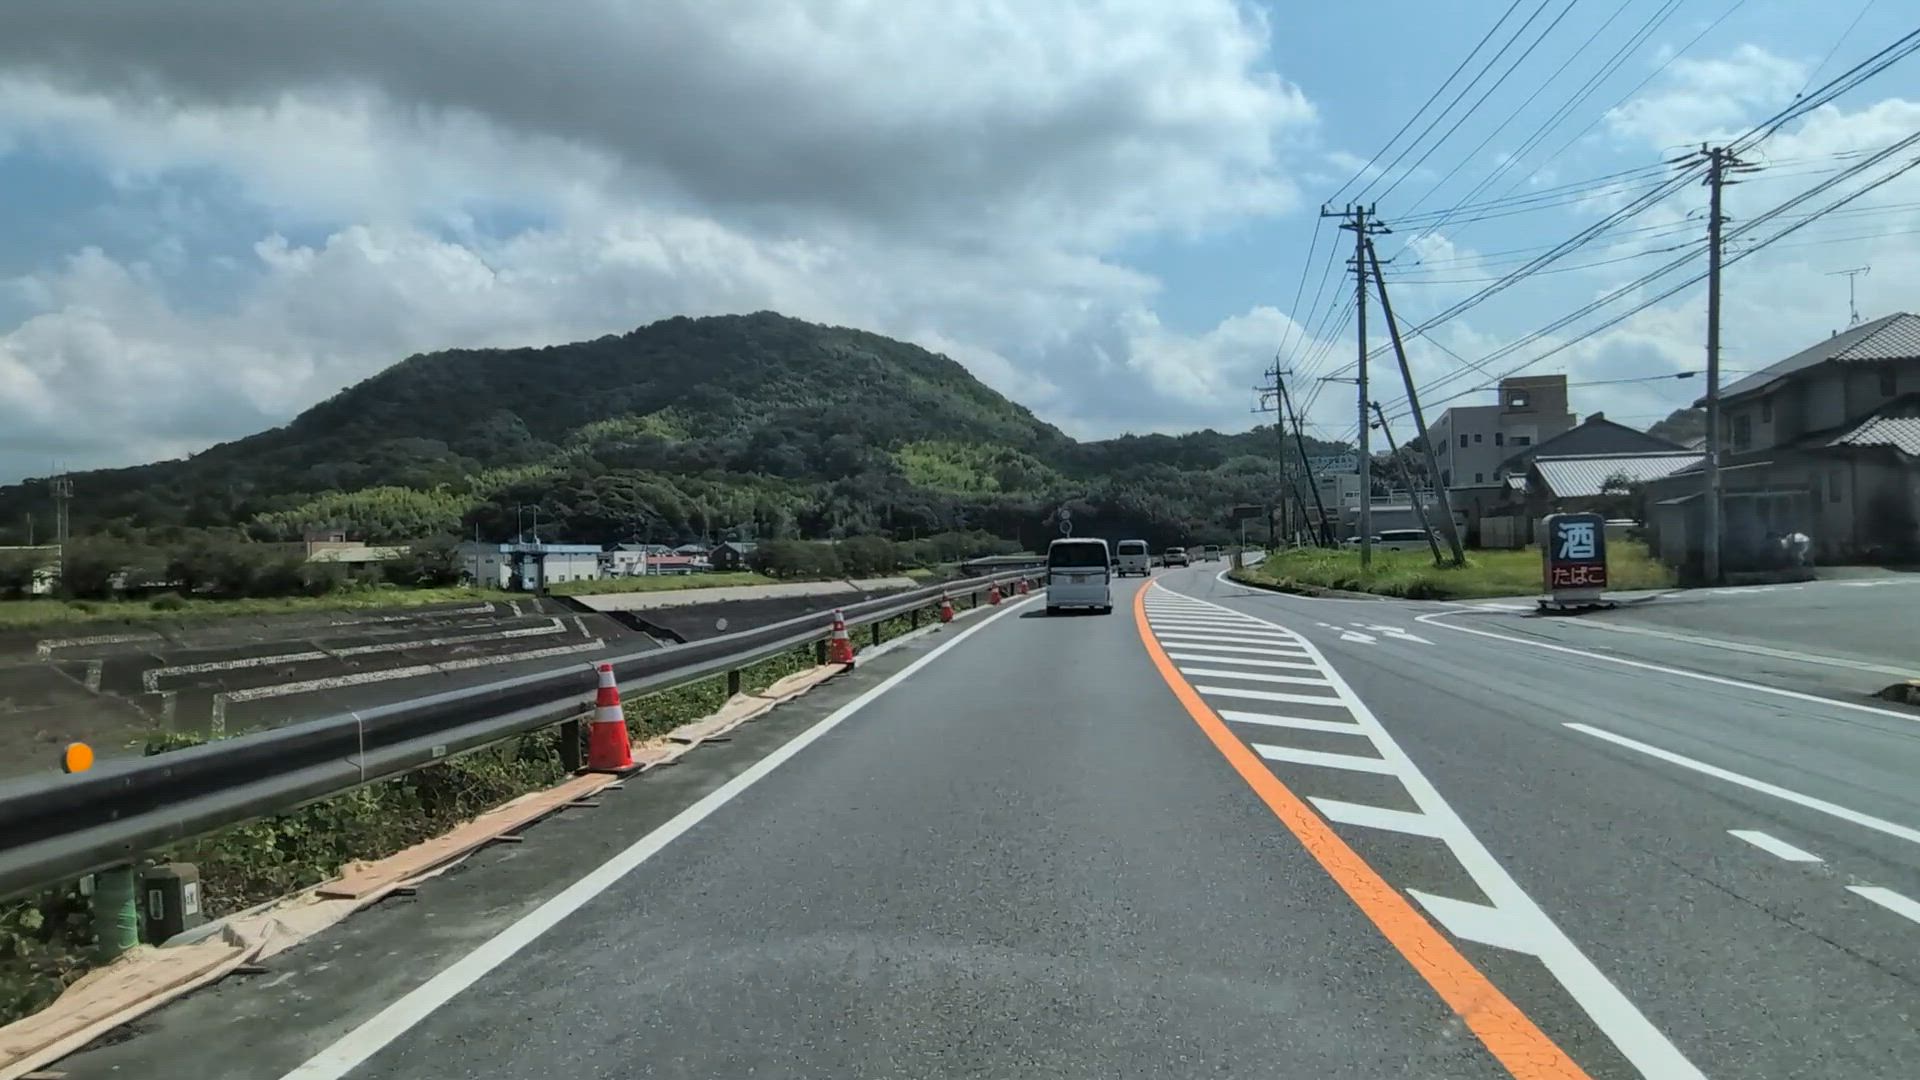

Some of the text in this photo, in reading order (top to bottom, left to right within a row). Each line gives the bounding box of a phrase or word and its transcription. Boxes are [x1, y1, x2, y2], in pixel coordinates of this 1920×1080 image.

[1558, 522, 1595, 559] 酒
[1553, 566, 1605, 585] たばこ
